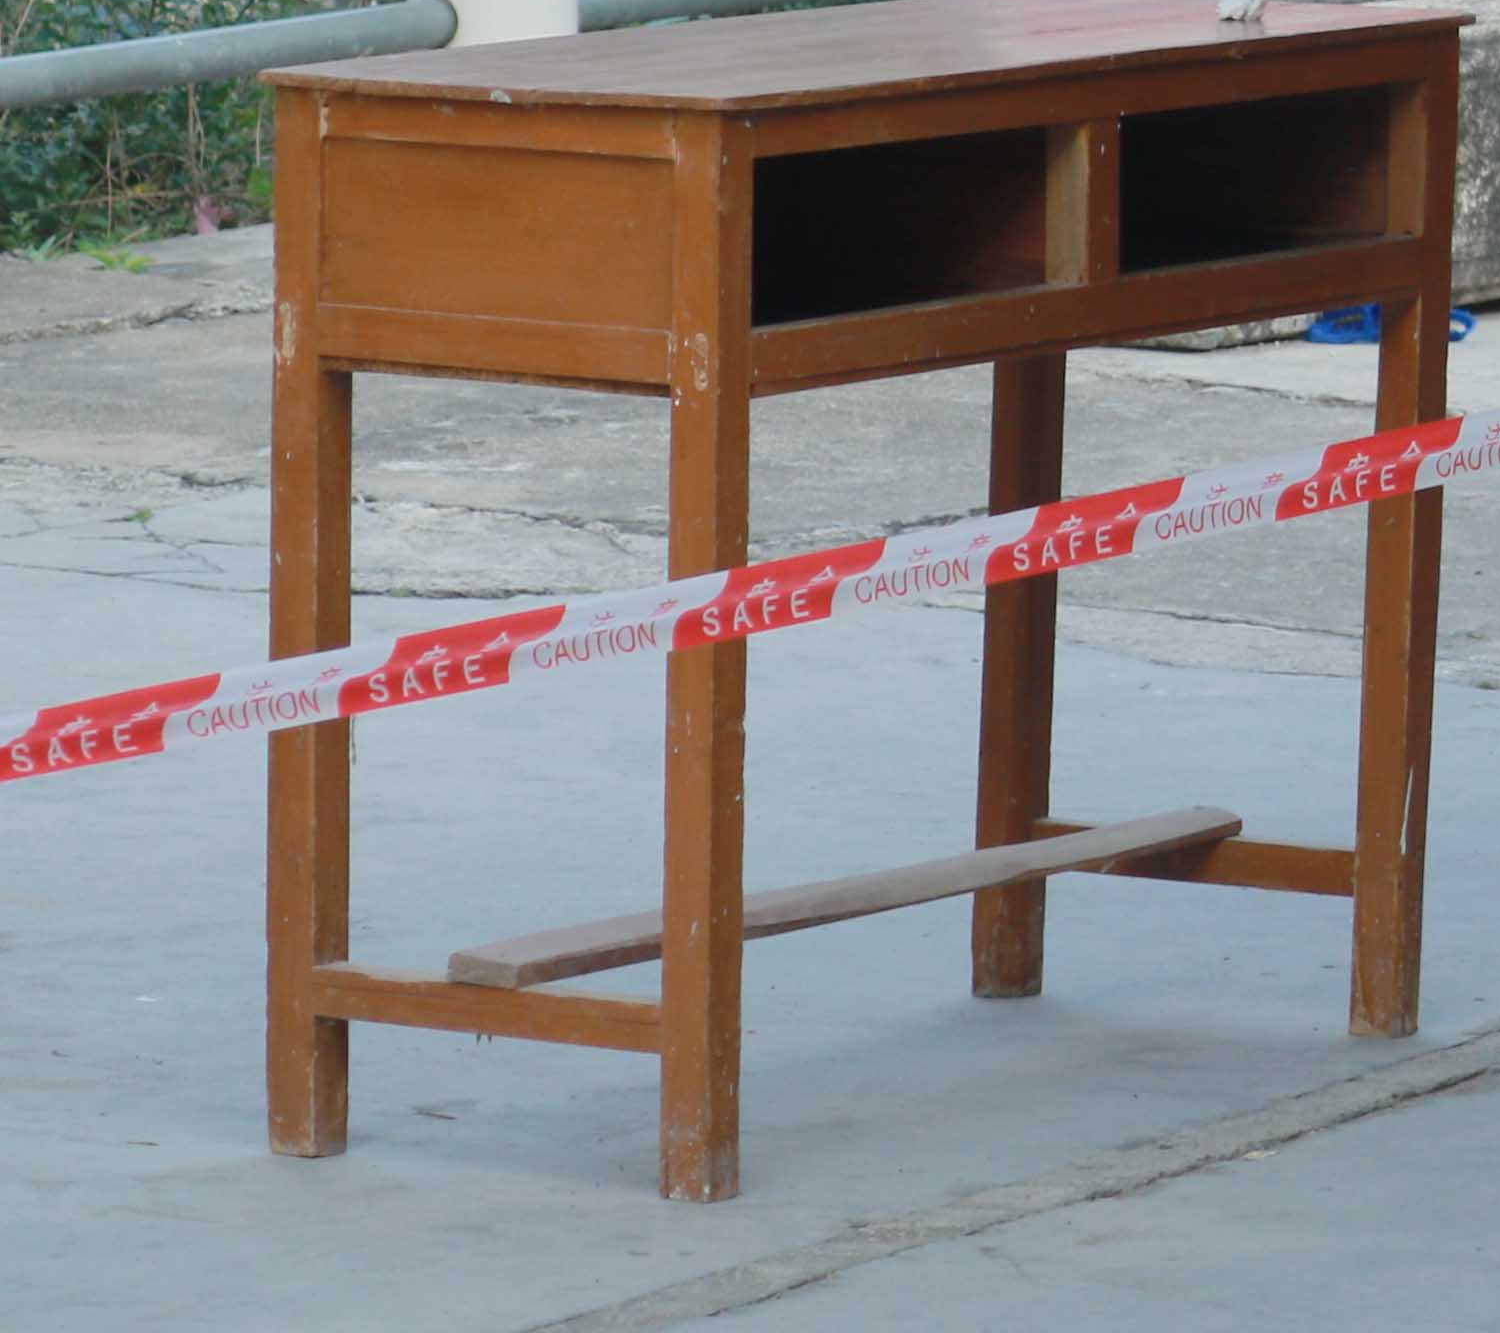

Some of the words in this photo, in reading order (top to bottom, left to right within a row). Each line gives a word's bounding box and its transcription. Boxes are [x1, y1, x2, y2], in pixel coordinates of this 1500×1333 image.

[11, 722, 138, 773] SAFE
[186, 686, 321, 738] CAUTION
[368, 651, 487, 704] SAFE
[532, 621, 657, 670] CAUTION
[702, 587, 810, 637] SAFE
[854, 558, 971, 604] CAUTION
[1012, 523, 1114, 572] SAFE
[1155, 494, 1264, 541] CAUTION
[1302, 462, 1397, 509] SAFE
